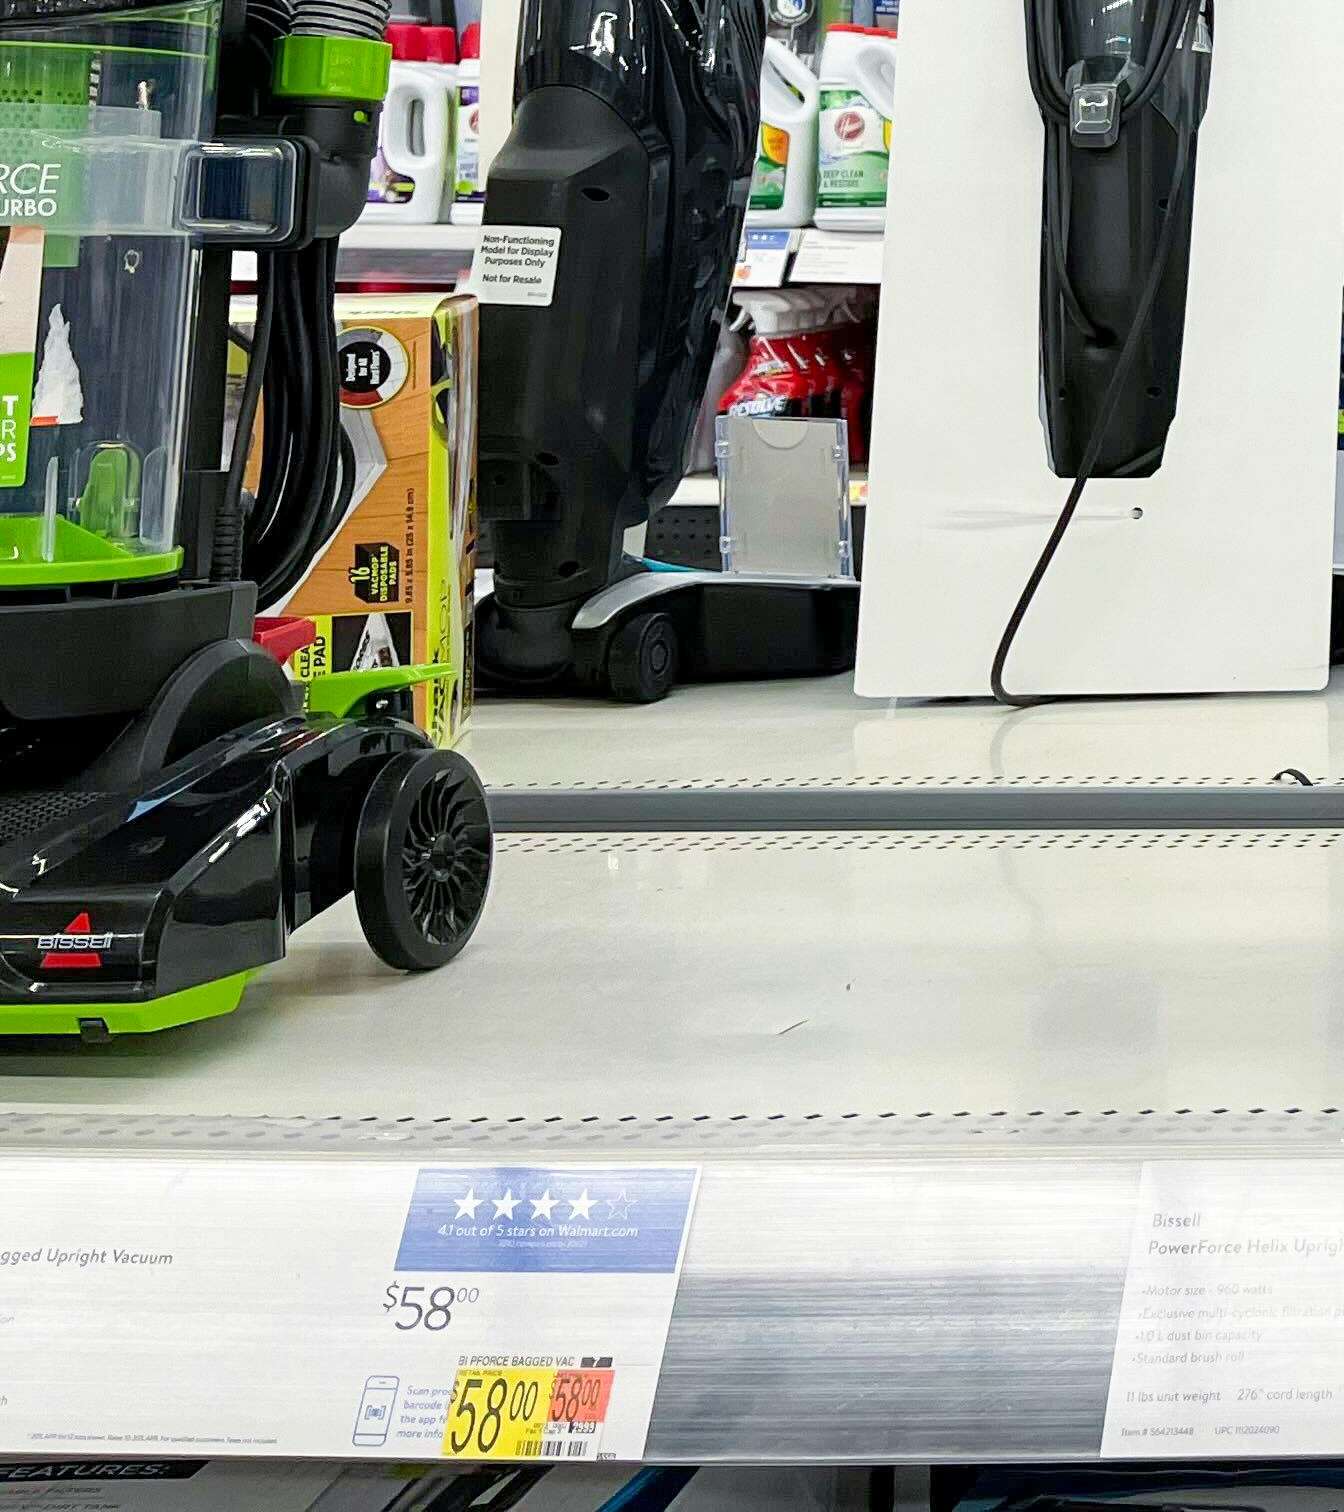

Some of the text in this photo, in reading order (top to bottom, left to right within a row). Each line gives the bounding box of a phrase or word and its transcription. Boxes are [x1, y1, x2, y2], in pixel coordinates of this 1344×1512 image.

[0, 199, 57, 218] URBO
[482, 234, 556, 249] Non-Functioning
[480, 245, 555, 259] Model for Display
[484, 256, 546, 269] Purposes Only
[482, 273, 543, 286] Not for Resale
[379, 546, 389, 602] DISPOSABLE
[389, 560, 397, 586] PADS
[37, 931, 114, 950] BISSELL
[1151, 1212, 1203, 1229] Bissell
[456, 1226, 477, 1238] out
[479, 1225, 494, 1238] of
[495, 1225, 505, 1238] 5
[506, 1226, 537, 1239] stars
[538, 1227, 556, 1239] on
[558, 1225, 639, 1239] Walmart.com
[1147, 1240, 1243, 1256] PowerForce
[1246, 1240, 1289, 1255] Helix
[0, 1248, 174, 1267] gged Upright Vacuum
